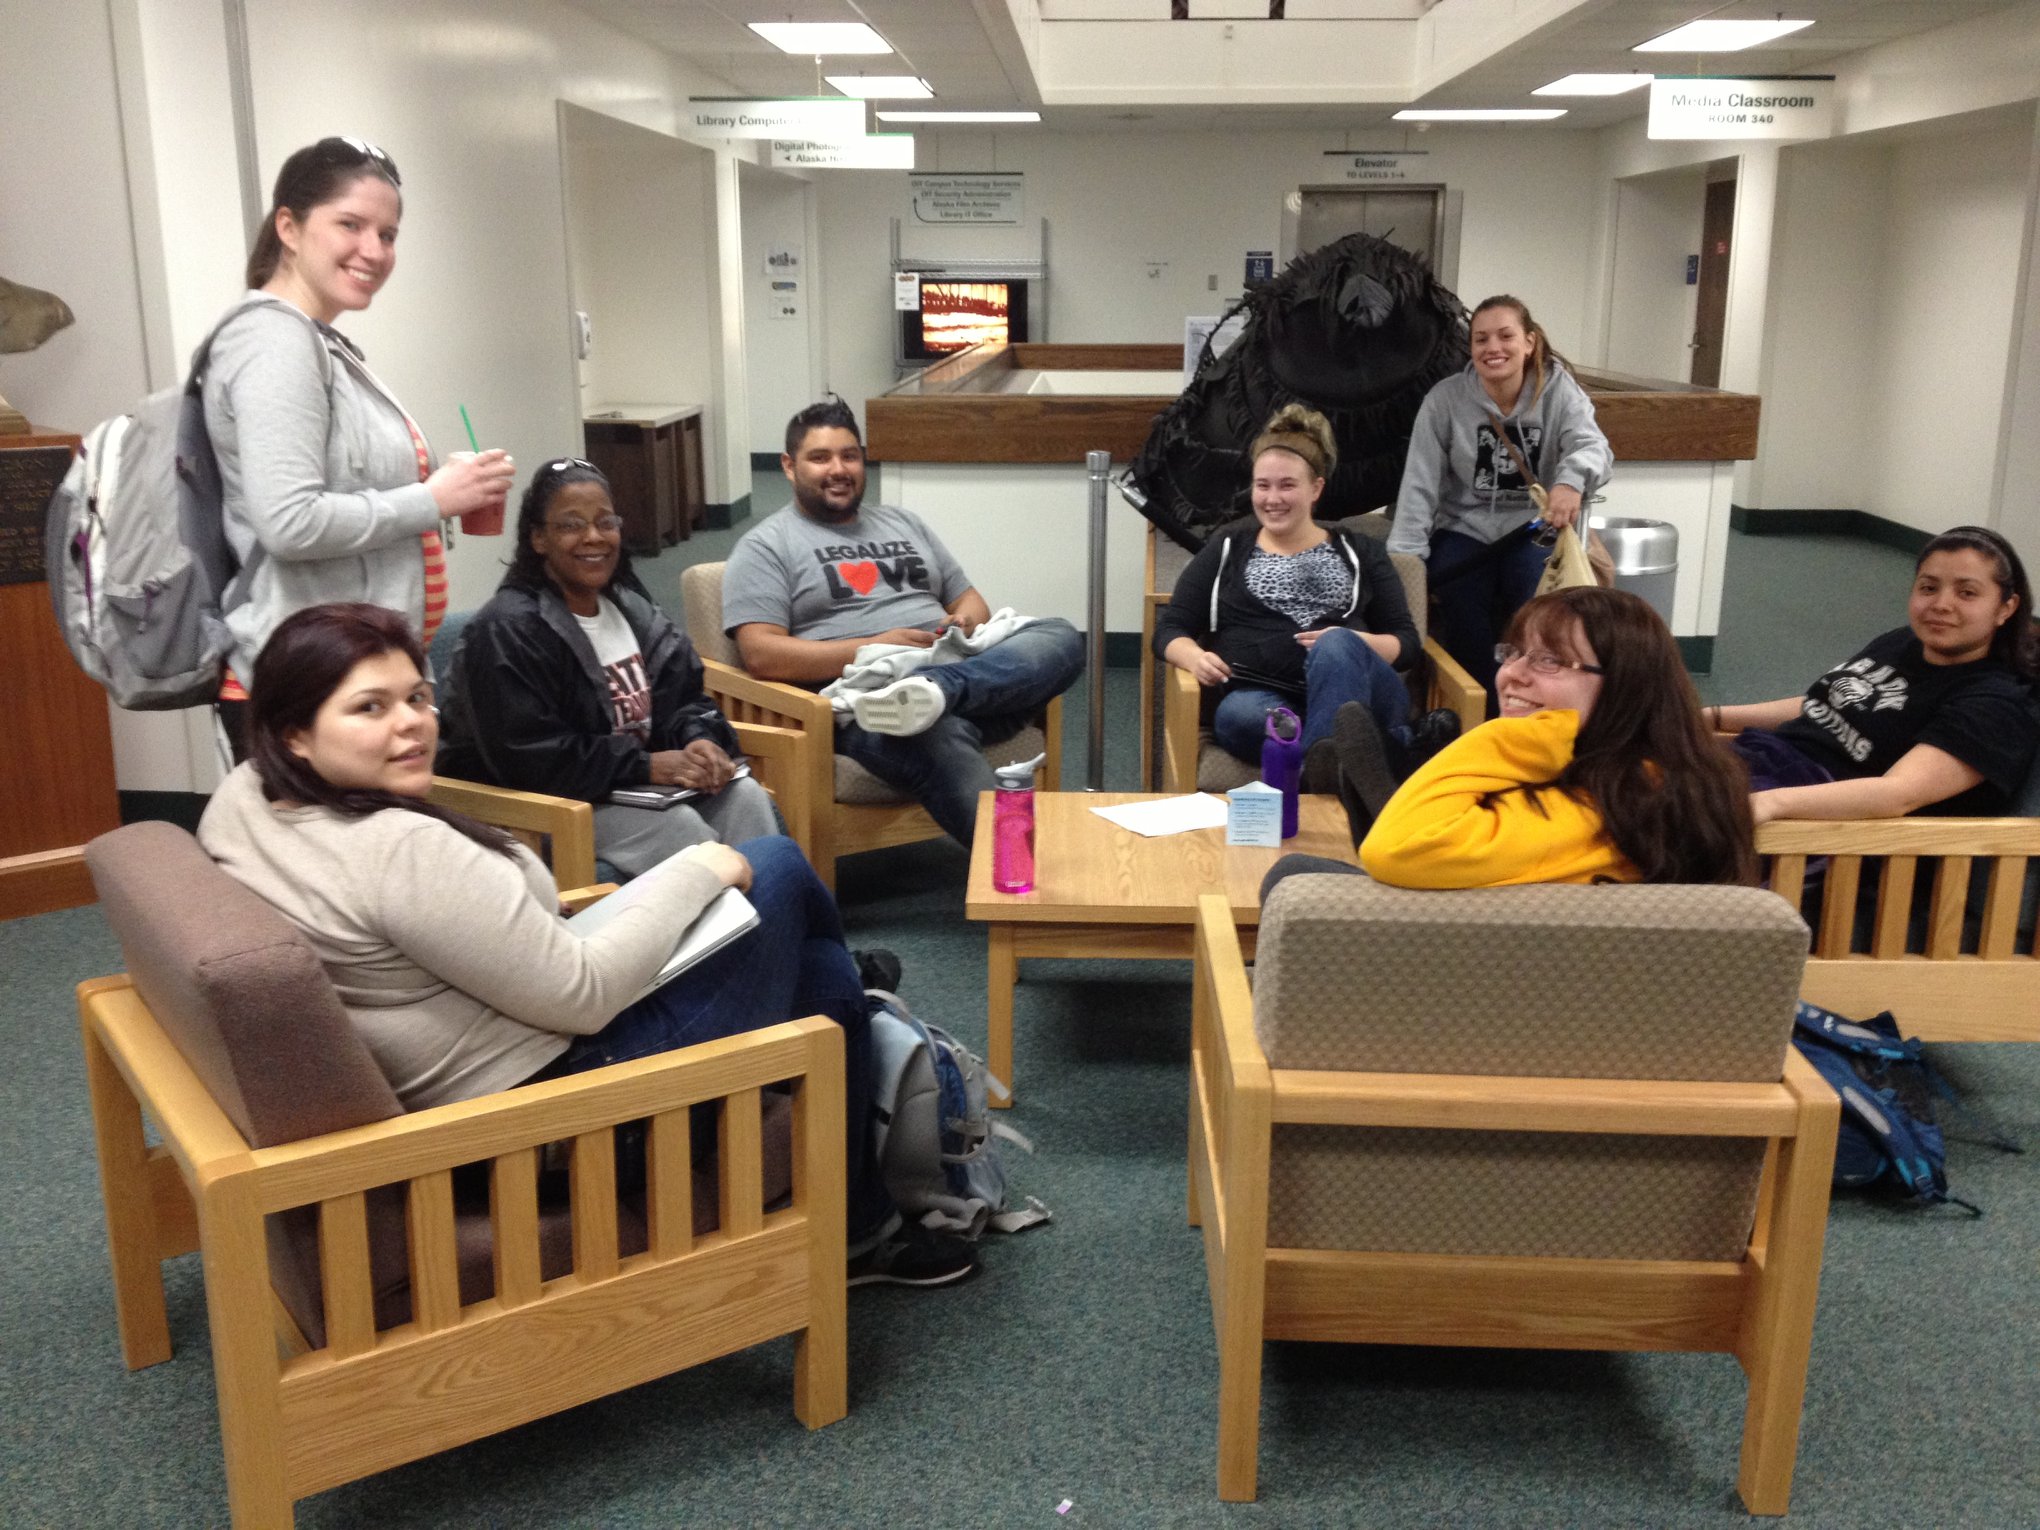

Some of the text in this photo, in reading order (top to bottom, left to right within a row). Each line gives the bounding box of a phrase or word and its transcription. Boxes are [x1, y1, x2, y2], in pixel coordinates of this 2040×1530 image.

[1728, 93, 1814, 108] Classroom
[696, 115, 736, 128] Library
[1708, 114, 1774, 124] ROOM 340
[774, 141, 805, 153] Digital
[796, 154, 827, 163] Alaska
[1355, 158, 1398, 168] Elevator
[952, 180, 991, 189] Technology
[934, 191, 961, 199] Security
[940, 211, 963, 219] Library
[814, 540, 919, 564] LEGALIZE
